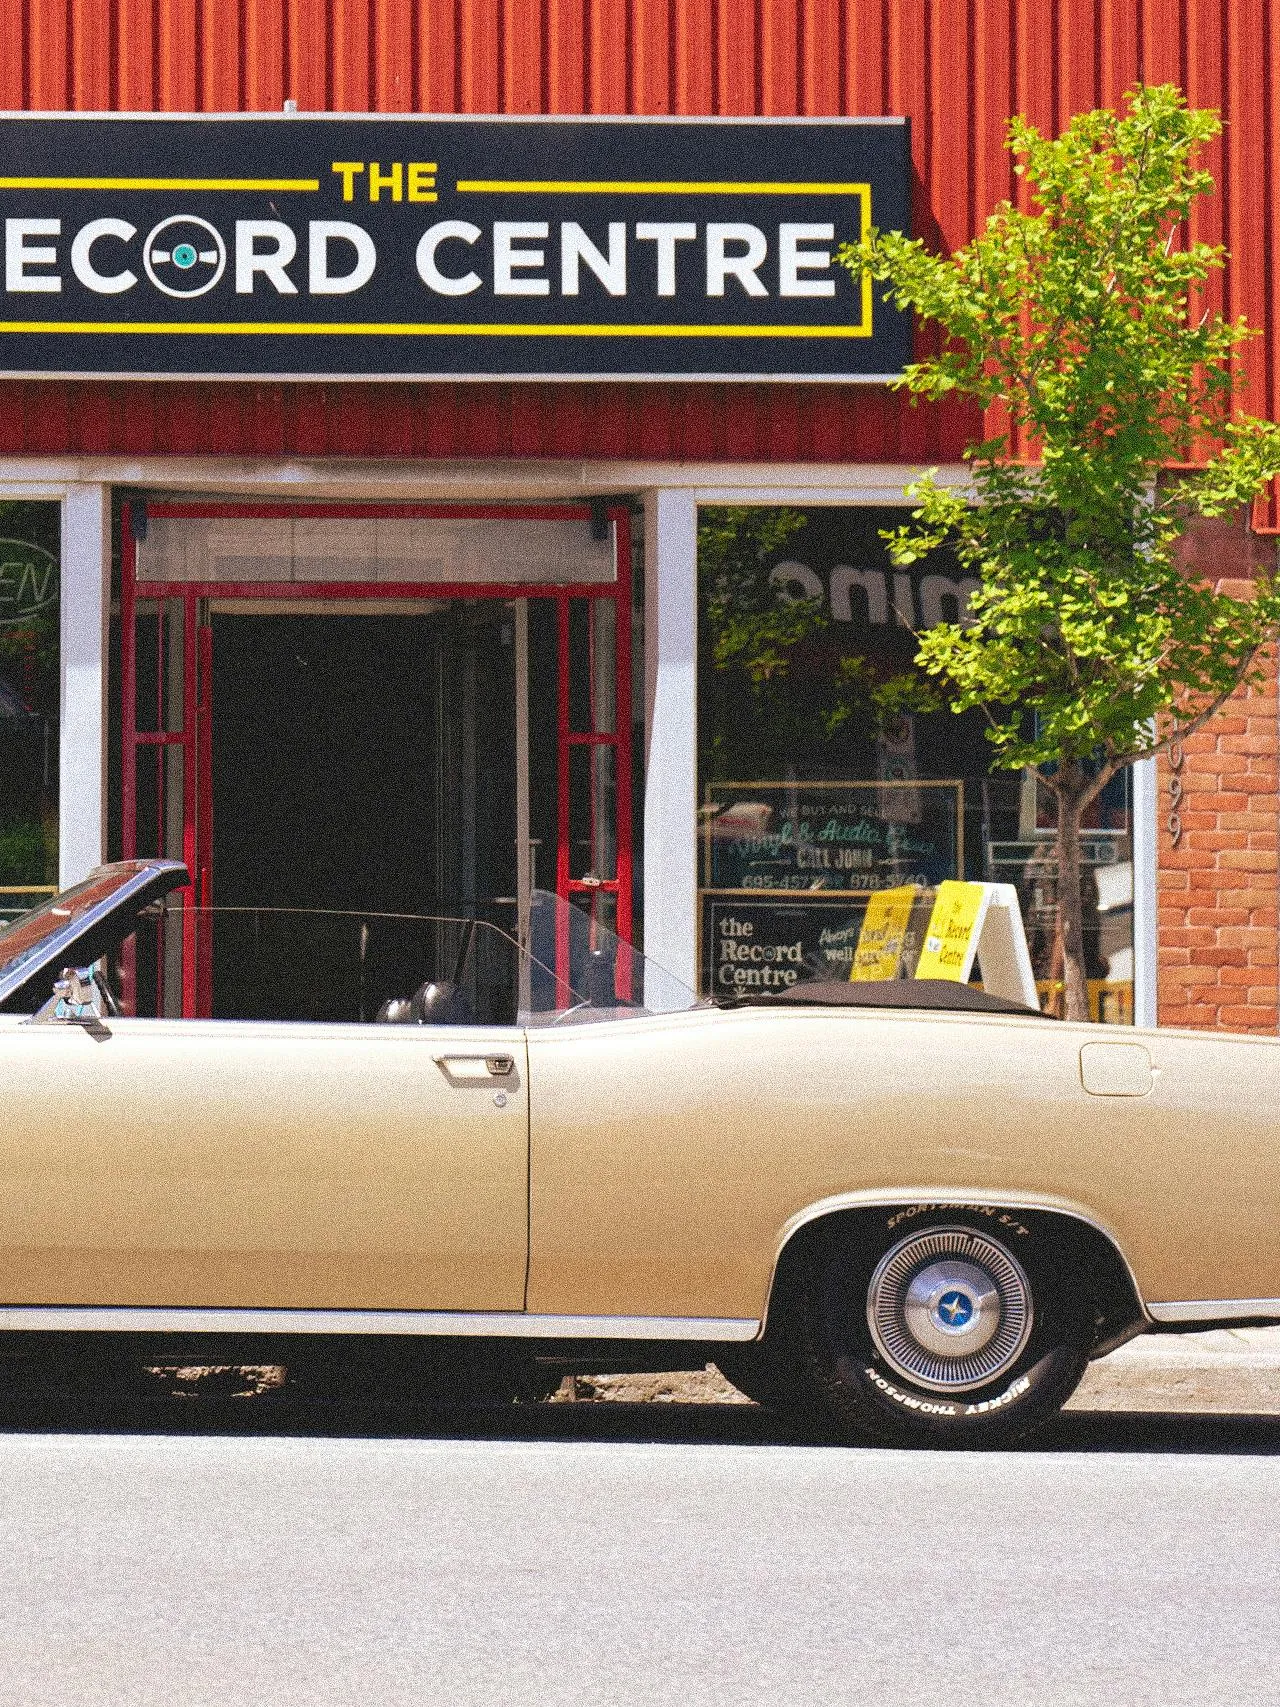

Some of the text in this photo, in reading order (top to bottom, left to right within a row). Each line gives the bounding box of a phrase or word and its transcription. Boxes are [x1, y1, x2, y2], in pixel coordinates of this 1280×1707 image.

[332, 162, 439, 202] THE
[416, 221, 837, 299] CENTRE
[829, 803, 857, 815] AND
[818, 819, 882, 843] Audio
[719, 917, 753, 938] the
[719, 939, 803, 963] Record
[824, 946, 853, 961] well
[718, 963, 798, 986] Centre
[865, 1366, 1031, 1416] MICKEY THOMPSON
